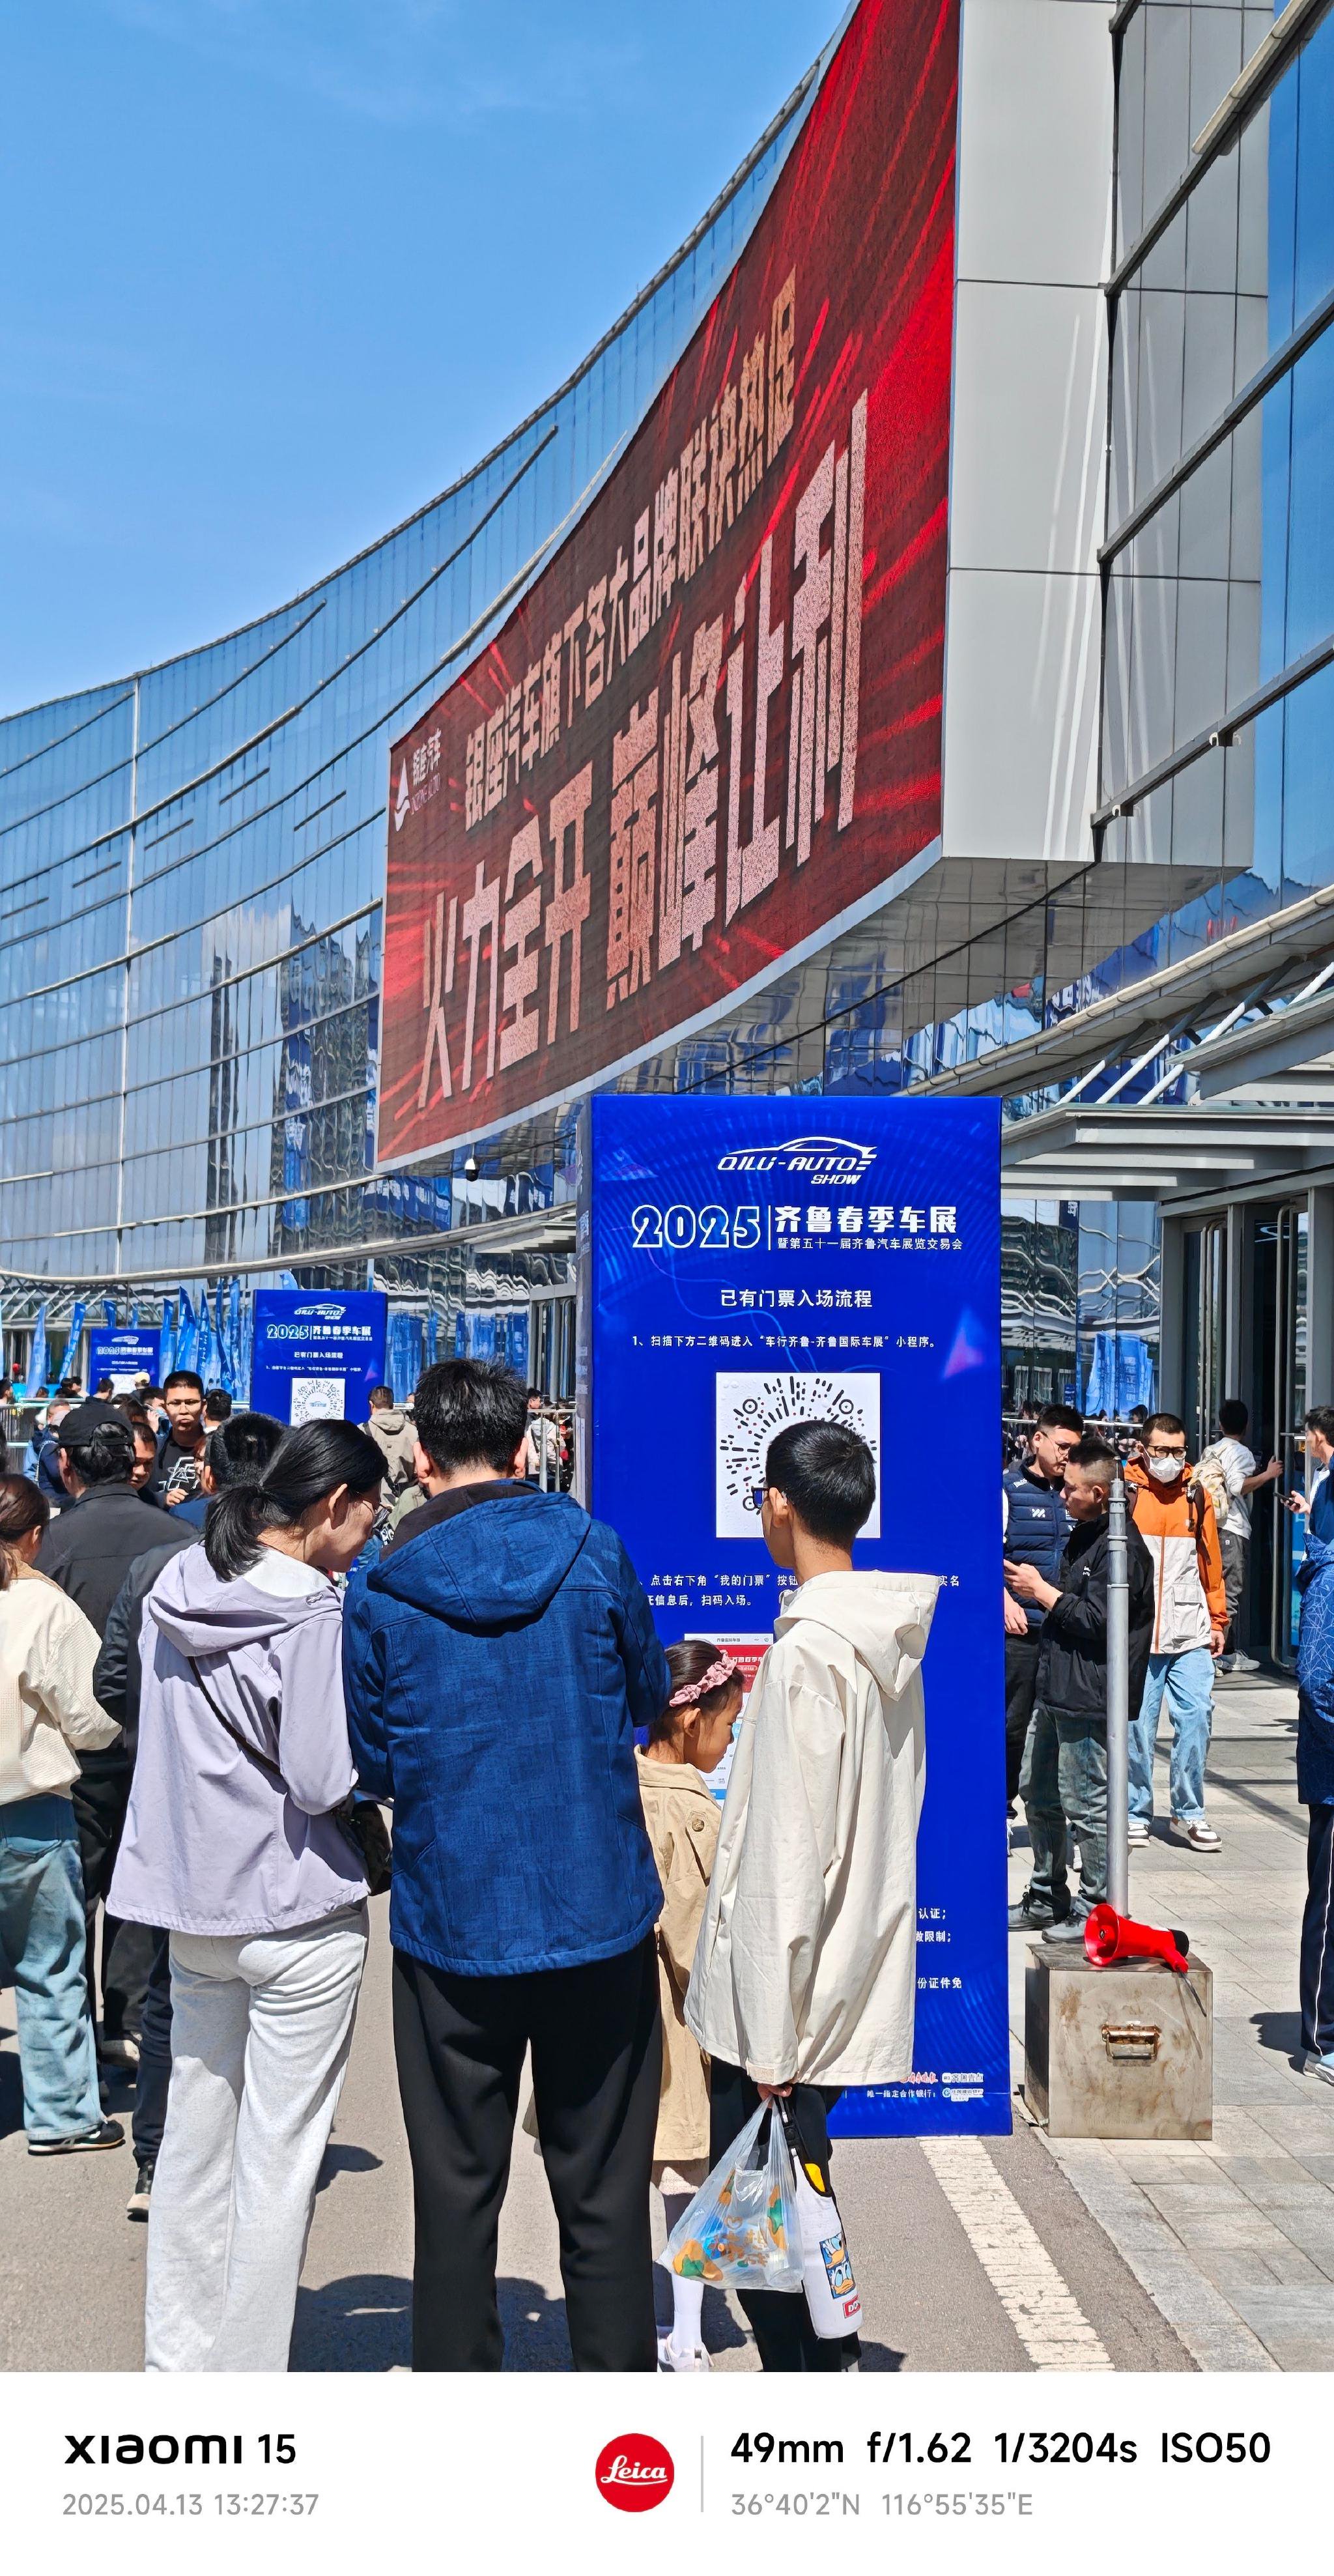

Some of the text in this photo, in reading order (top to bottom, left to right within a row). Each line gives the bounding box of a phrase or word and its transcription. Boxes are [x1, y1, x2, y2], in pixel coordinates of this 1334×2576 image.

[418, 388, 868, 1109] 火力全开 巅峰让利
[810, 1174, 862, 1185] SHOW
[631, 1204, 957, 1249] 2025 齐鲁春季车展
[777, 1237, 963, 1250] 暨第五十一届齐鲁汽车展览交易会
[720, 1289, 873, 1308] 已有门票入场流程
[267, 1324, 309, 1340] 2025
[939, 1575, 959, 1588] 实名
[917, 1977, 962, 1989] 份证件免
